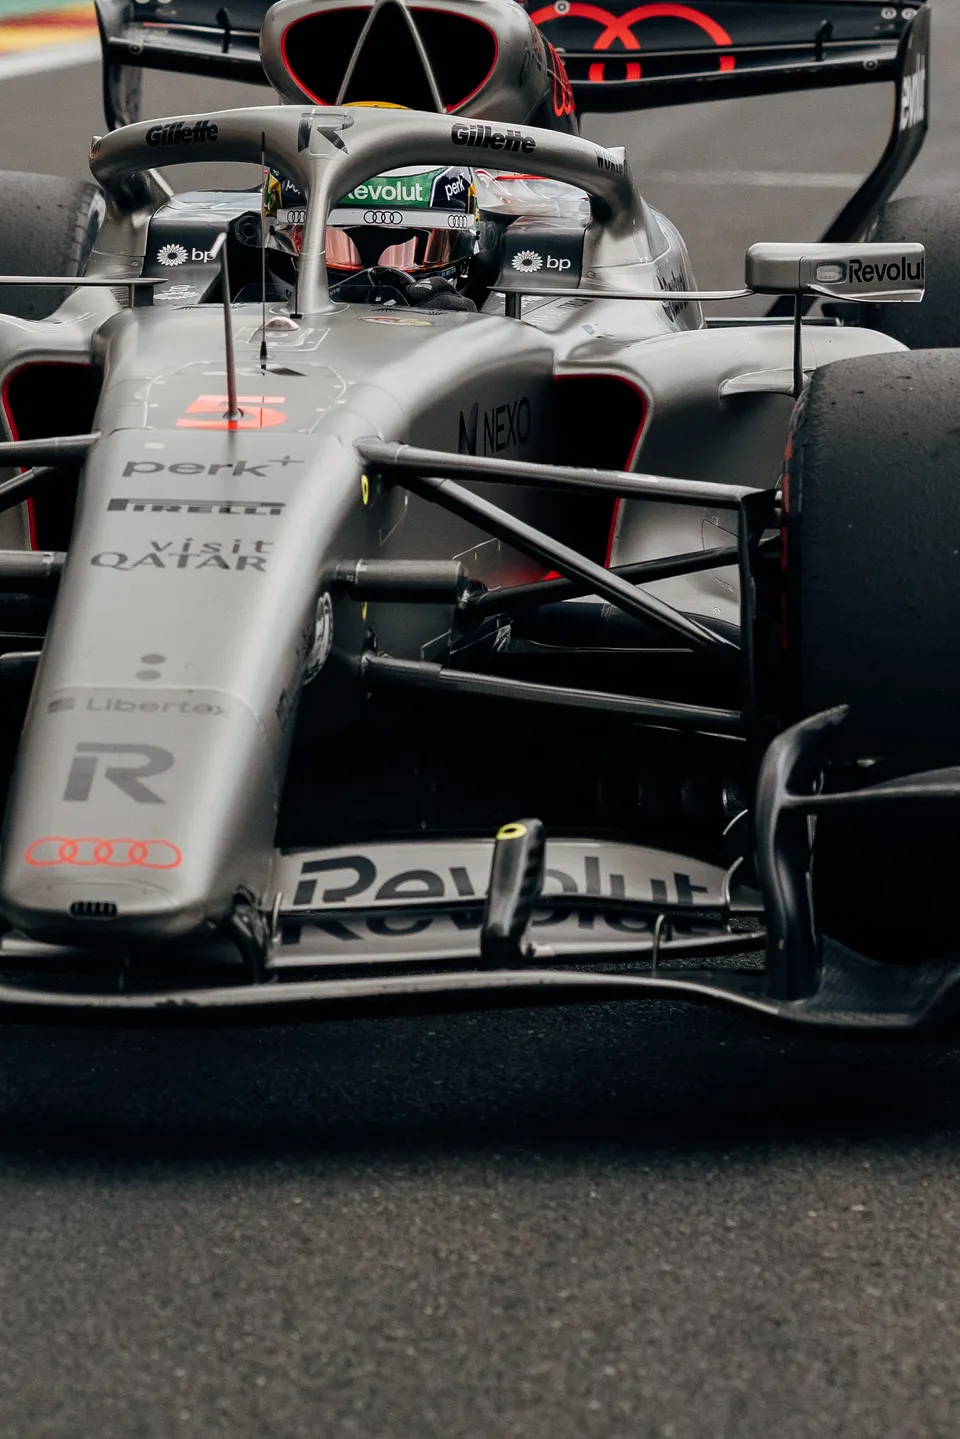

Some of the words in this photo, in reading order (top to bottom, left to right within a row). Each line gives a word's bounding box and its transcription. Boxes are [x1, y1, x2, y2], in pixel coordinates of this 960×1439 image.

[145, 119, 219, 147] Gillette
[450, 122, 537, 154] Gillette
[347, 181, 424, 202] evolut
[546, 255, 572, 271] bp
[176, 394, 287, 431] 5
[483, 396, 531, 457] NEXO
[106, 498, 287, 516] PIRELLI
[149, 537, 274, 555] visit
[91, 551, 268, 573] QATAR
[86, 697, 227, 717] Libertex
